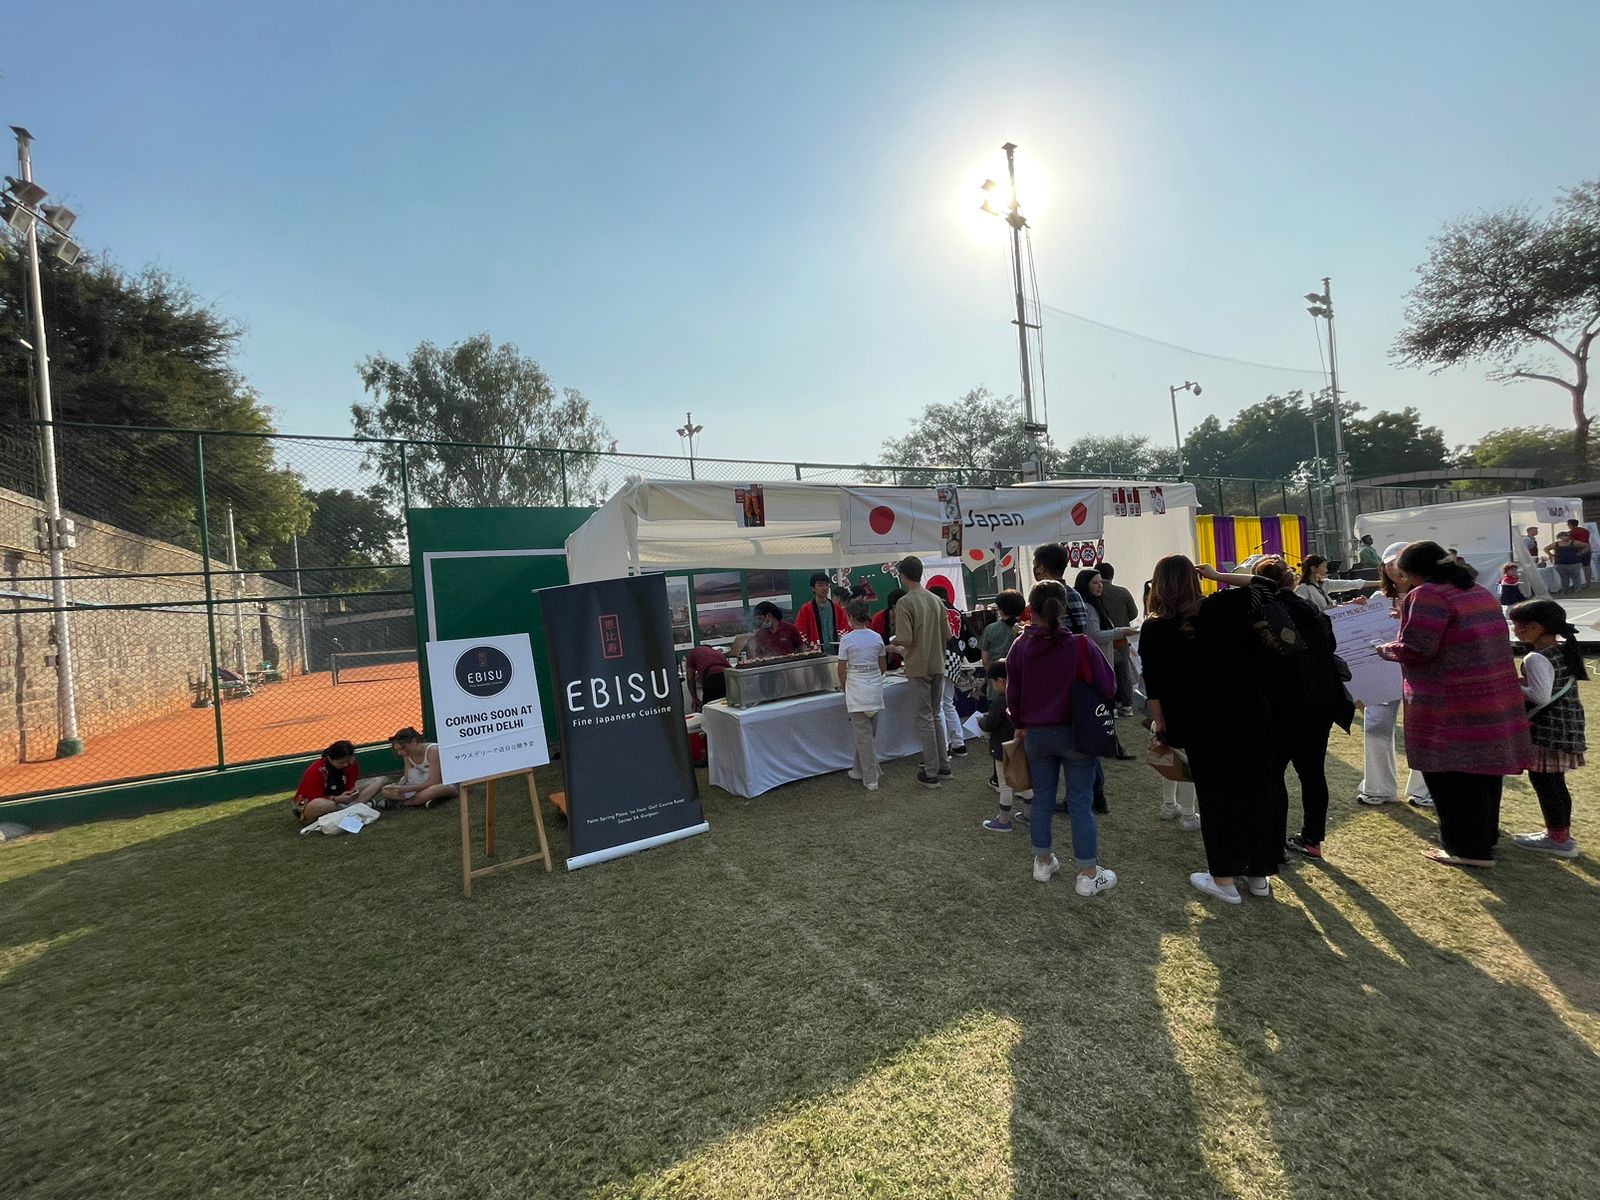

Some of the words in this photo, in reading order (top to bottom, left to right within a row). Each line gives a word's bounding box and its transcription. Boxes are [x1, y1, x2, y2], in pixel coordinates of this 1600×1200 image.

[965, 510, 1024, 531] Japan
[467, 669, 503, 684] EBISU
[566, 668, 670, 713] EBISU
[445, 712, 488, 727] COMING
[490, 706, 518, 720] SOON
[521, 705, 533, 715] AT
[573, 718, 593, 727] Fine
[595, 712, 636, 725] Japanese
[639, 705, 672, 717] Cuisine
[459, 723, 494, 738] SOUTH
[496, 718, 524, 732] DELHI
